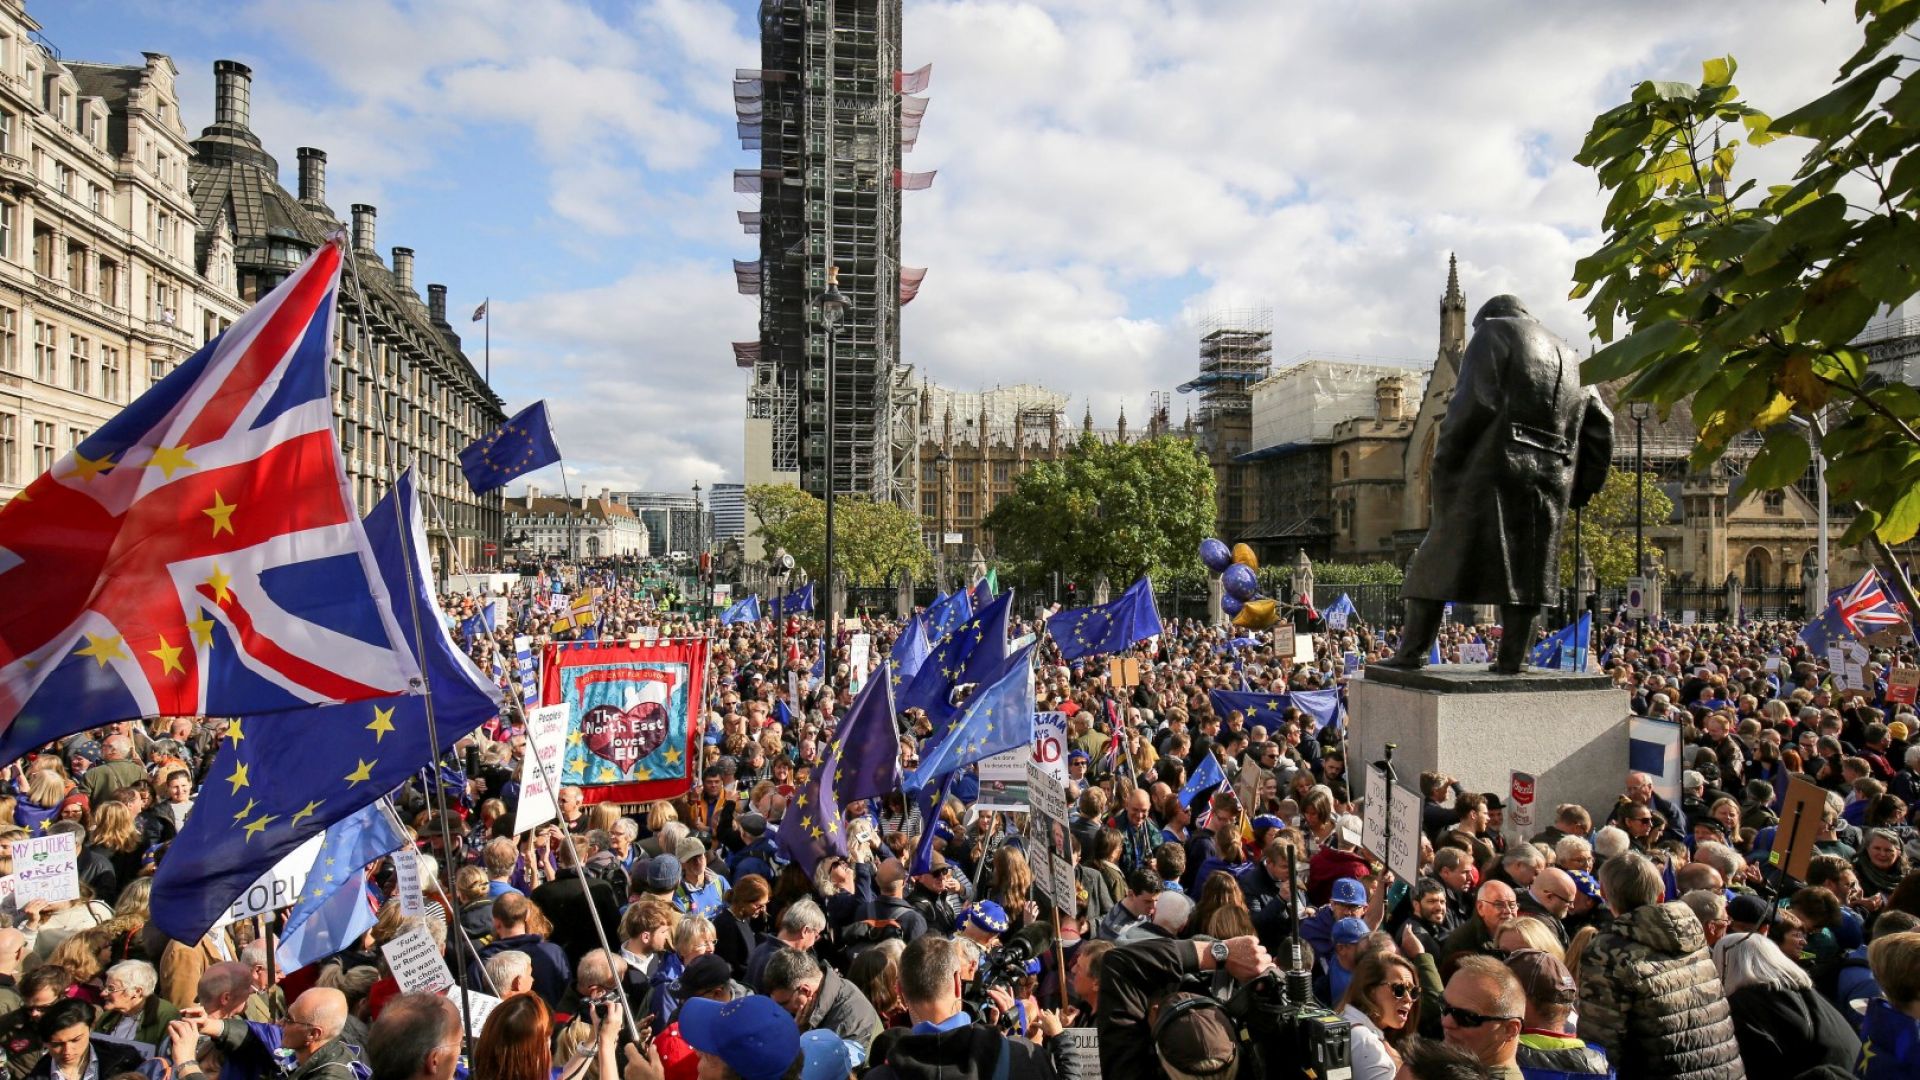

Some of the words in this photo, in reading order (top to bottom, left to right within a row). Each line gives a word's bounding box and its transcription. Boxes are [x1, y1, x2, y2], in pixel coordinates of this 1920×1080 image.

[594, 709, 620, 723] The
[1034, 713, 1067, 734] RHAM
[586, 721, 627, 735] North
[631, 719, 665, 733] East
[1034, 729, 1050, 738] AYS
[611, 736, 646, 748] loves
[614, 747, 639, 761] EU
[1390, 798, 1408, 817] USY
[13, 843, 29, 859] MY
[33, 834, 73, 854] FUTURE
[20, 861, 75, 880] WRECK
[231, 873, 307, 919] EOPL
[393, 963, 402, 971] or
[402, 944, 436, 966] Remain?
[402, 968, 417, 978] We
[417, 957, 436, 971] want
[403, 978, 417, 988] the
[418, 964, 443, 980] choice
